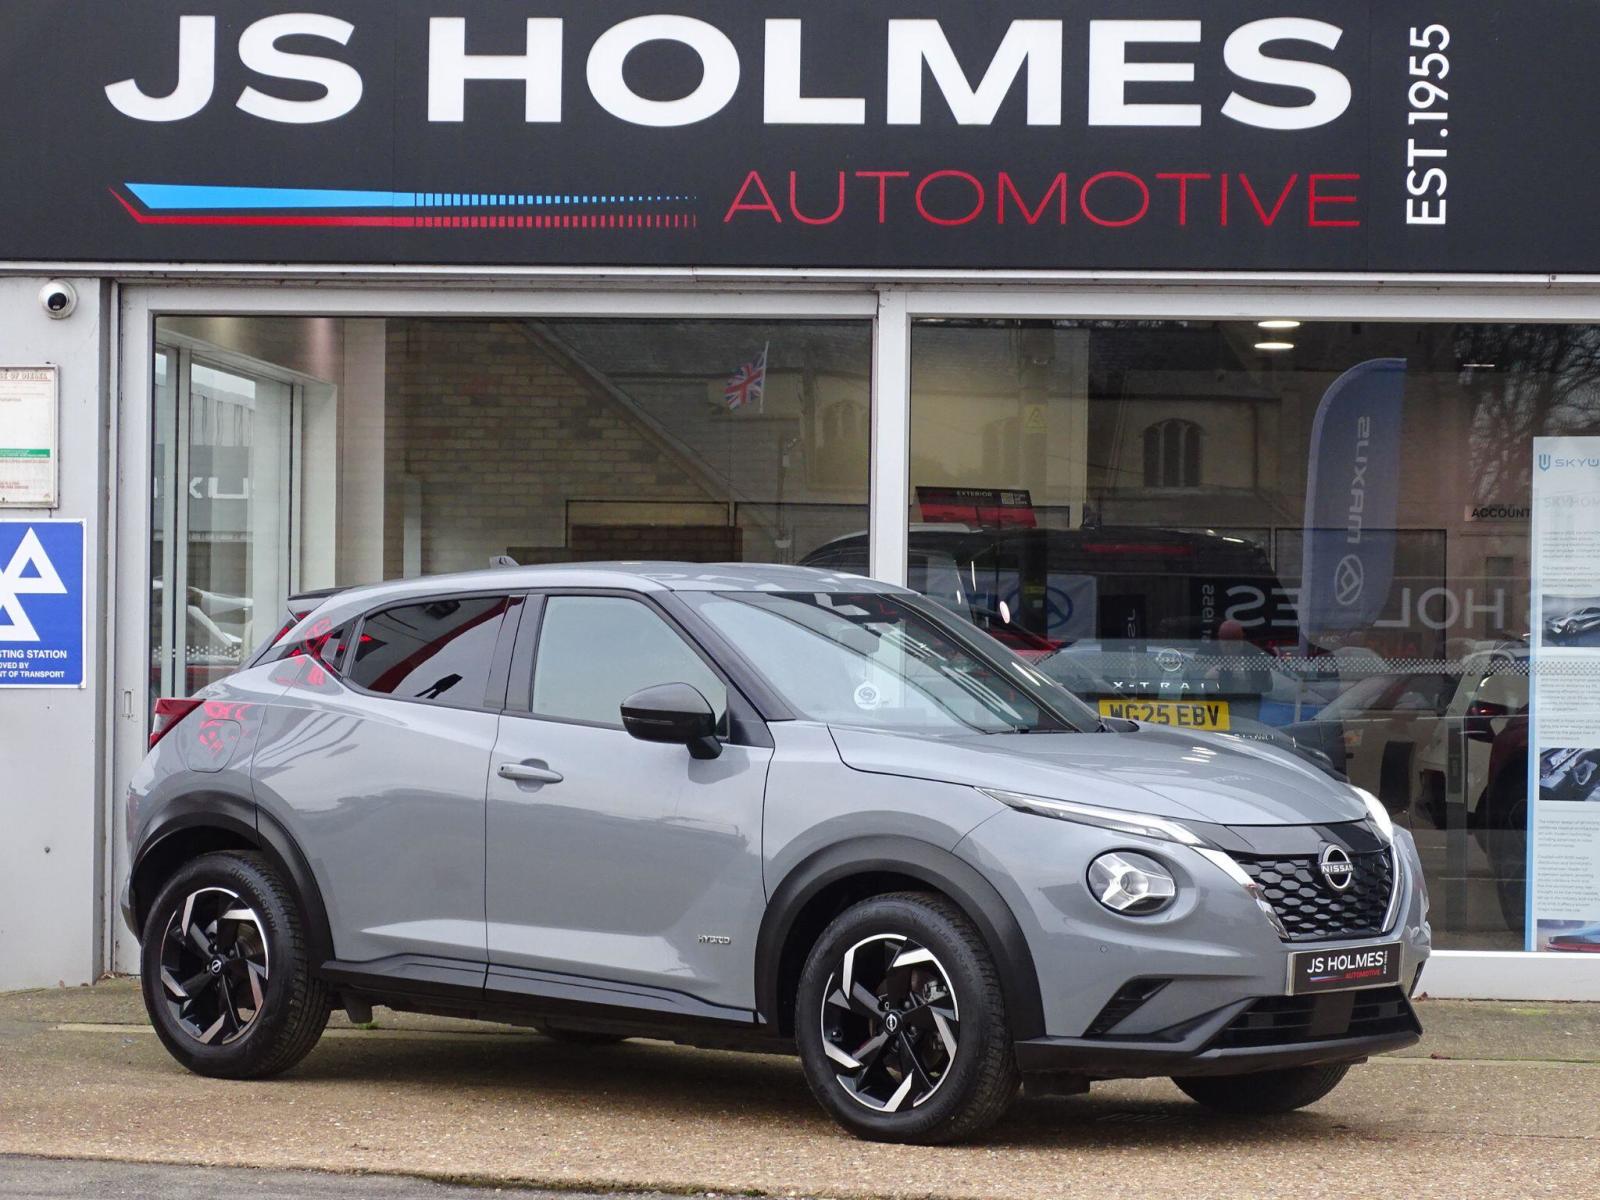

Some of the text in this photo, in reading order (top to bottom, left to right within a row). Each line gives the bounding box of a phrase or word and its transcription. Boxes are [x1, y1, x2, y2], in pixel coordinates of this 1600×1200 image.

[104, 12, 1353, 131] JS HOLMES
[1406, 24, 1451, 225] EST.1955
[723, 169, 1361, 228] AUTOMOTIVE
[956, 489, 993, 498] EXTERIOR
[0, 649, 68, 659] TING STATION
[1109, 704, 1219, 726] WG25 EBV
[1321, 861, 1354, 874] NISSAN
[1307, 957, 1325, 974] JS
[1327, 951, 1384, 971] HOLMES
